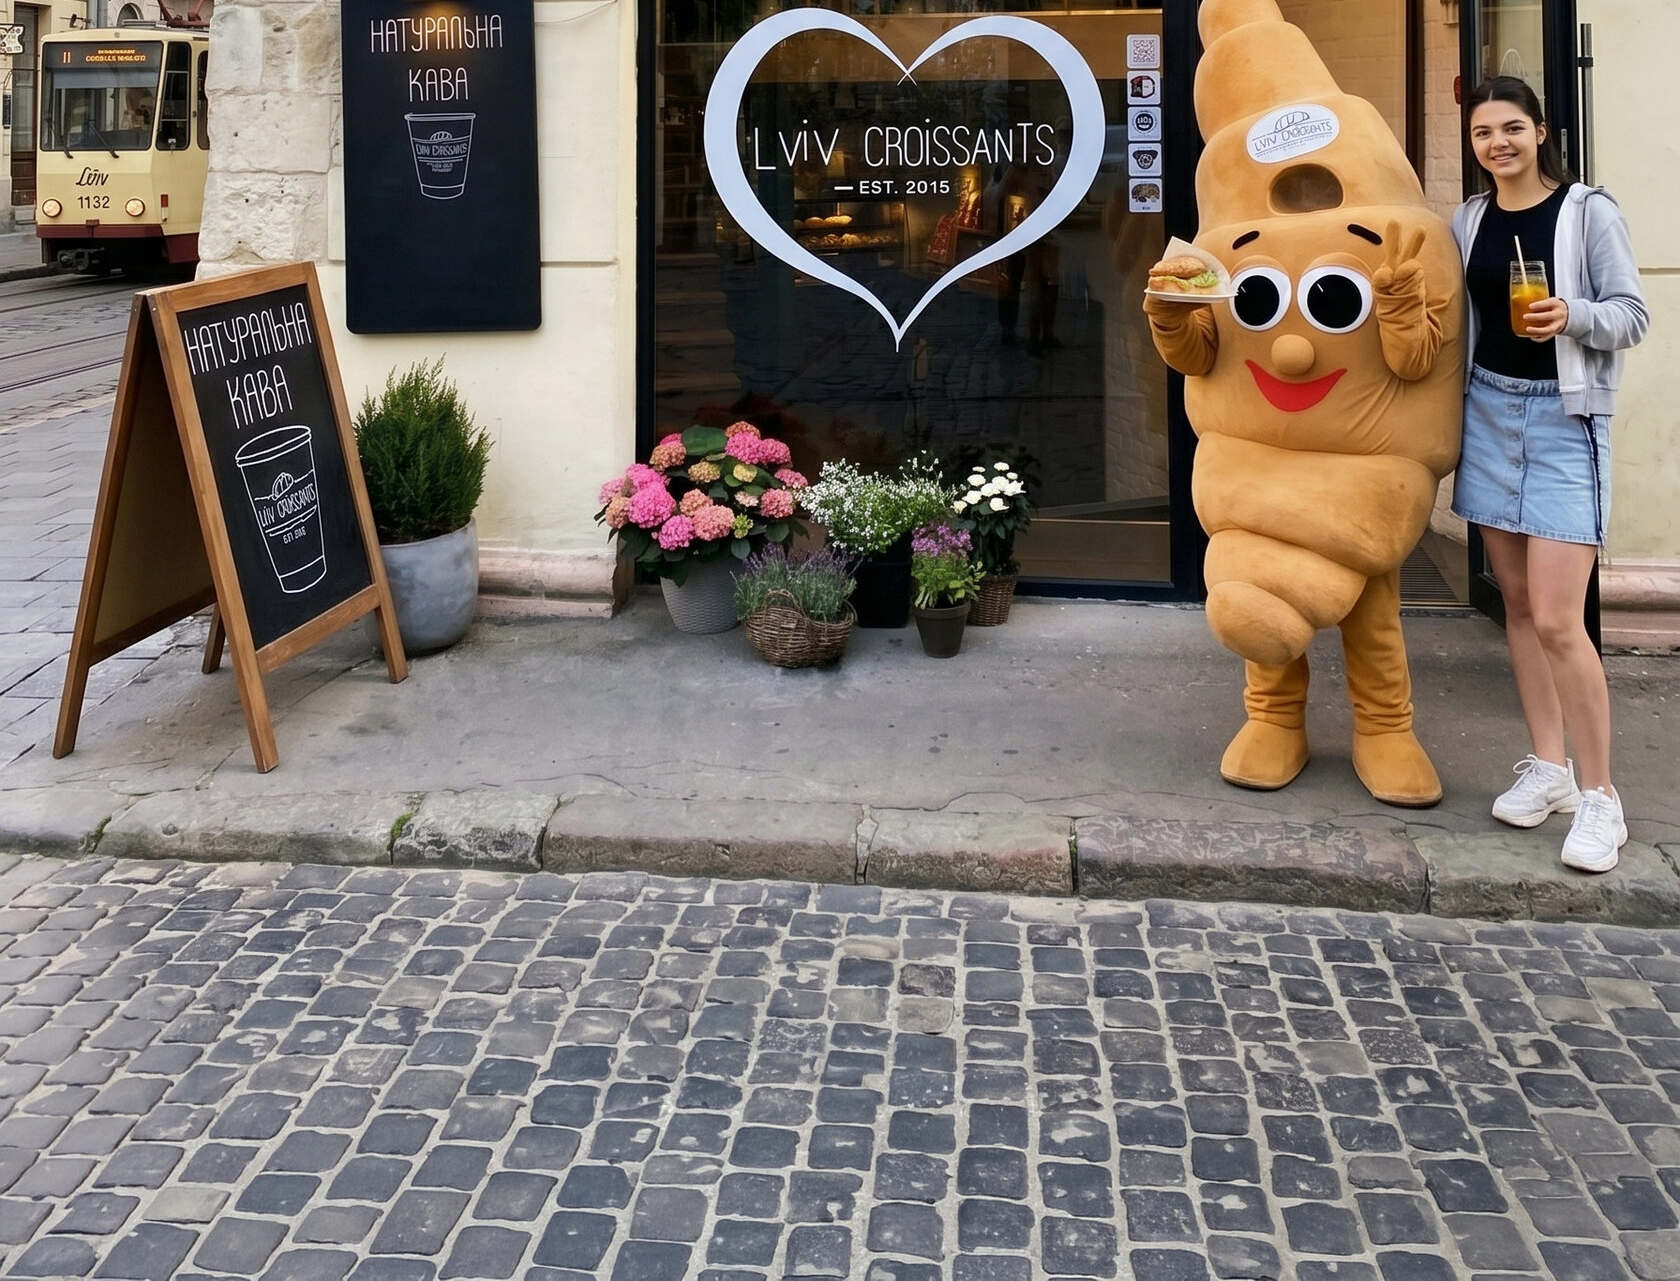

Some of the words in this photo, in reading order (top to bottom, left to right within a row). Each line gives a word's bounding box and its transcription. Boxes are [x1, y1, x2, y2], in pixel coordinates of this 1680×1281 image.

[370, 14, 503, 53] НАТУРАЛЬНА
[408, 67, 469, 102] КАВА
[77, 195, 110, 209] 1132
[859, 180, 898, 195] EST.
[905, 180, 950, 195] 2015
[184, 302, 312, 375] НАТУРАЛЬНА
[226, 364, 293, 429] КАВА
